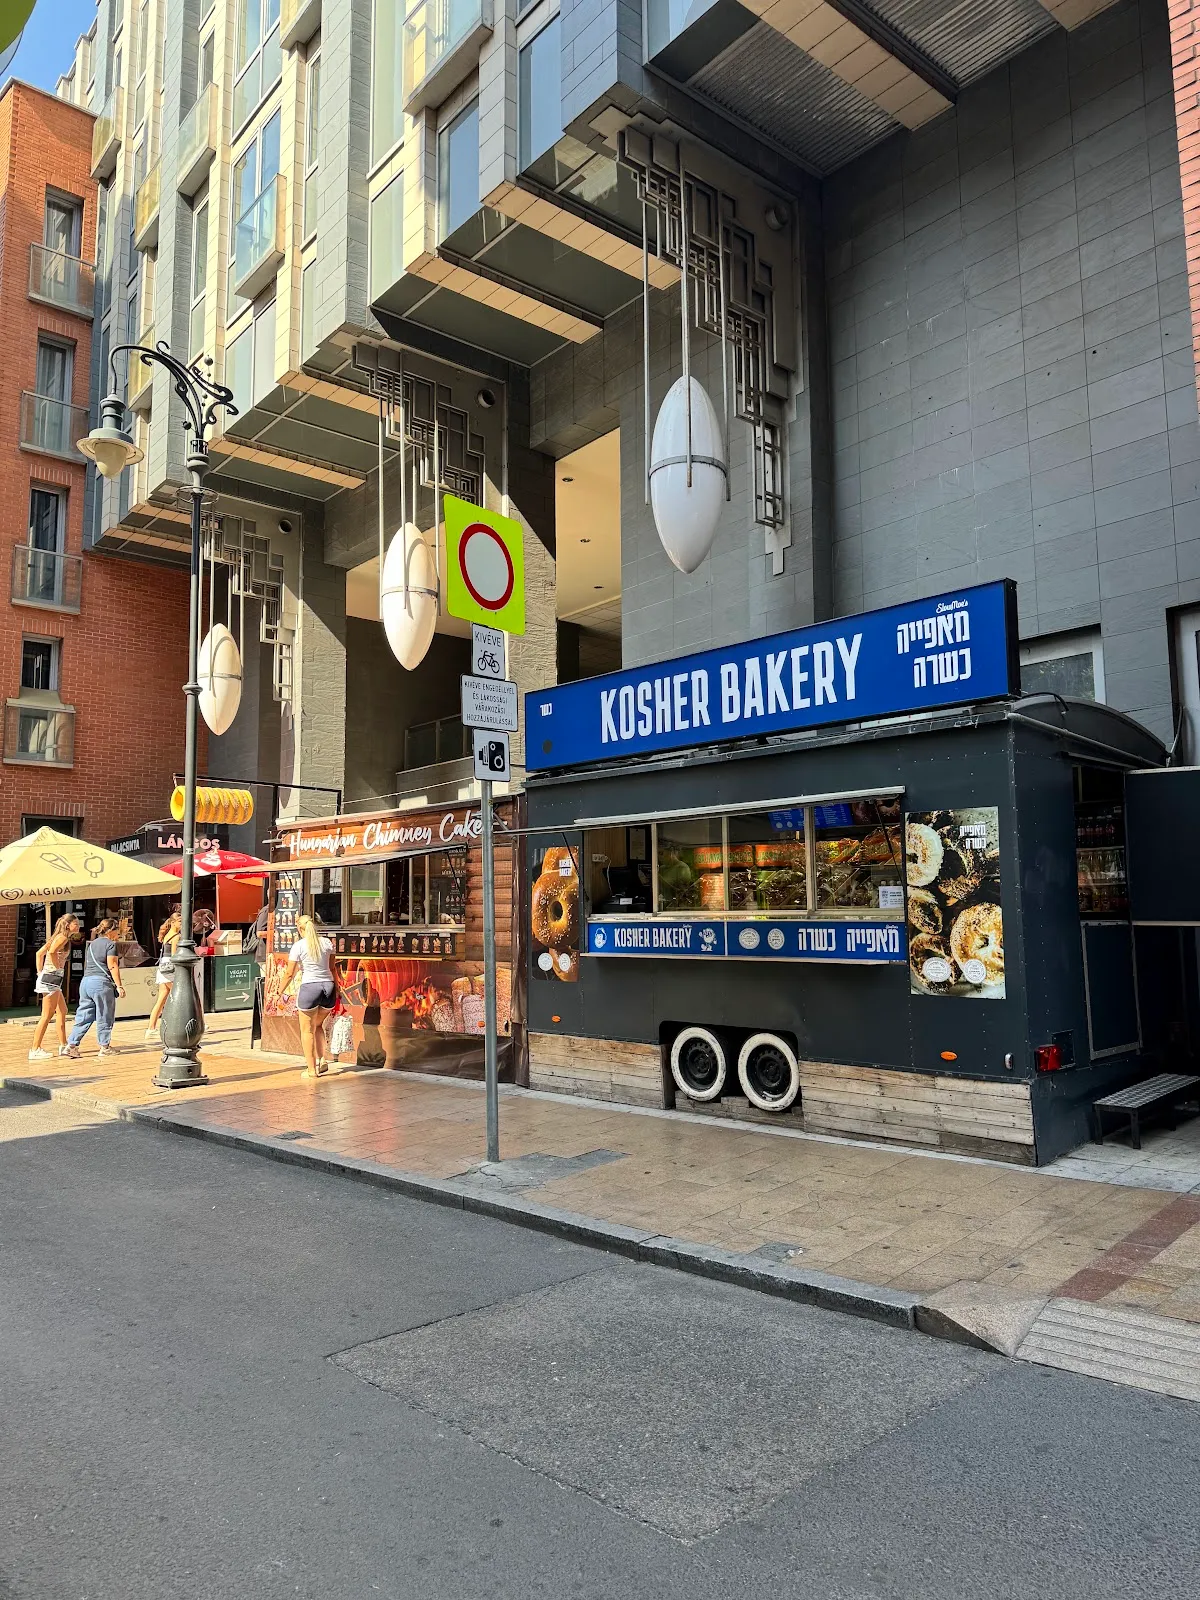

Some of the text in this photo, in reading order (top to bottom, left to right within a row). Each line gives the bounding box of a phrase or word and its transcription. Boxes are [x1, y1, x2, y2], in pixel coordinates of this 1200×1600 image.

[475, 631, 501, 647] KIVÉVE
[897, 610, 970, 654] מאפייה
[914, 648, 971, 688] כשרה
[464, 681, 481, 690] KIVÉVE
[472, 690, 480, 700] ÉS
[601, 633, 862, 743] KOSHER BAKERY
[540, 702, 552, 716] כשר
[289, 828, 357, 858] Hungarian
[363, 820, 432, 850] Chimney
[29, 886, 71, 896] ALGIDA
[614, 927, 692, 948] KOSHER BAKERY
[798, 928, 836, 951] כשרה
[846, 928, 900, 953] מאפייה
